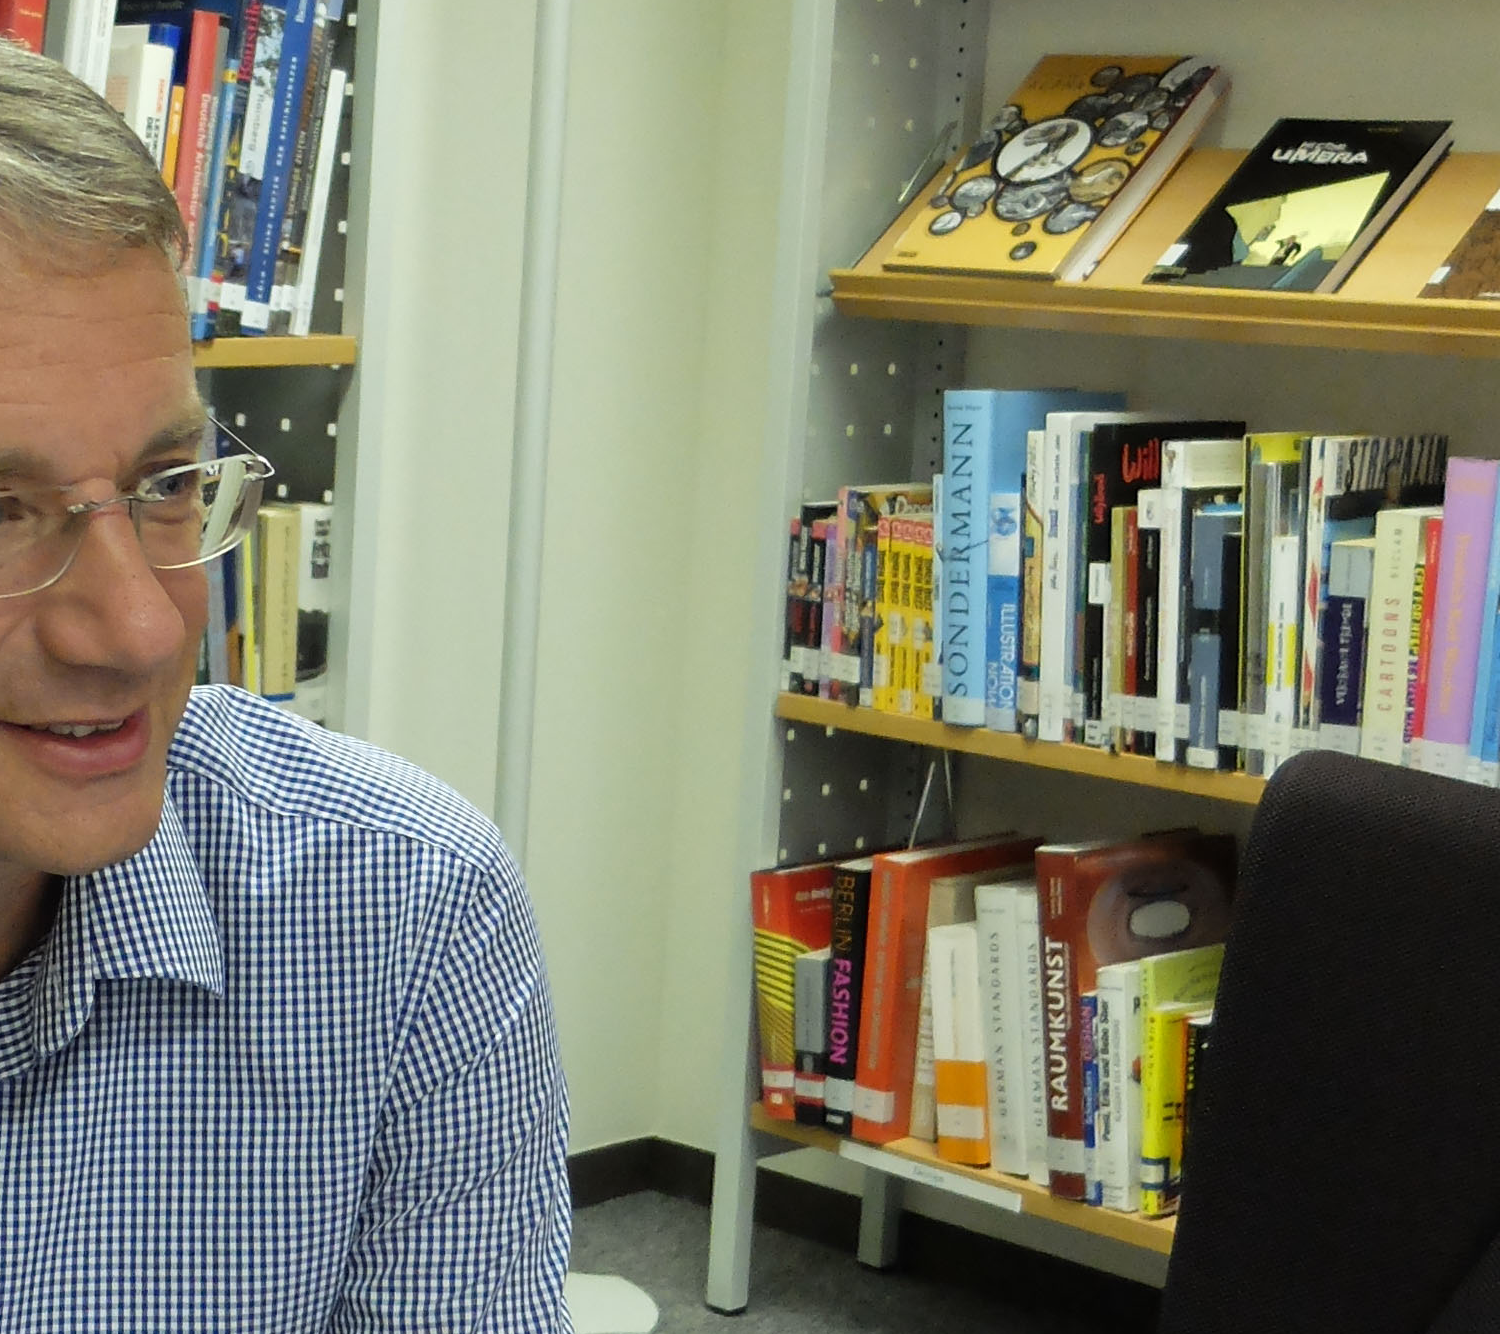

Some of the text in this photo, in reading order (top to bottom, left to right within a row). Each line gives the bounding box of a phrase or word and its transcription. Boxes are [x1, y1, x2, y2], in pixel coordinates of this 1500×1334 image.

[188, 93, 211, 217] Deutsche Architektur
[1272, 147, 1368, 165] UMBRA
[1122, 437, 1160, 484] Will
[946, 421, 973, 697] SONDERMANN
[999, 602, 1018, 713] ILLUSTRATION
[1376, 597, 1401, 713] CARTOONS
[828, 875, 856, 1065] BERLIN FASHION
[988, 930, 1008, 1118] GERMAN STANDARDS
[1026, 942, 1044, 1128] GERMAN STANDARDS
[1044, 936, 1069, 1112] RAUMKUNST
